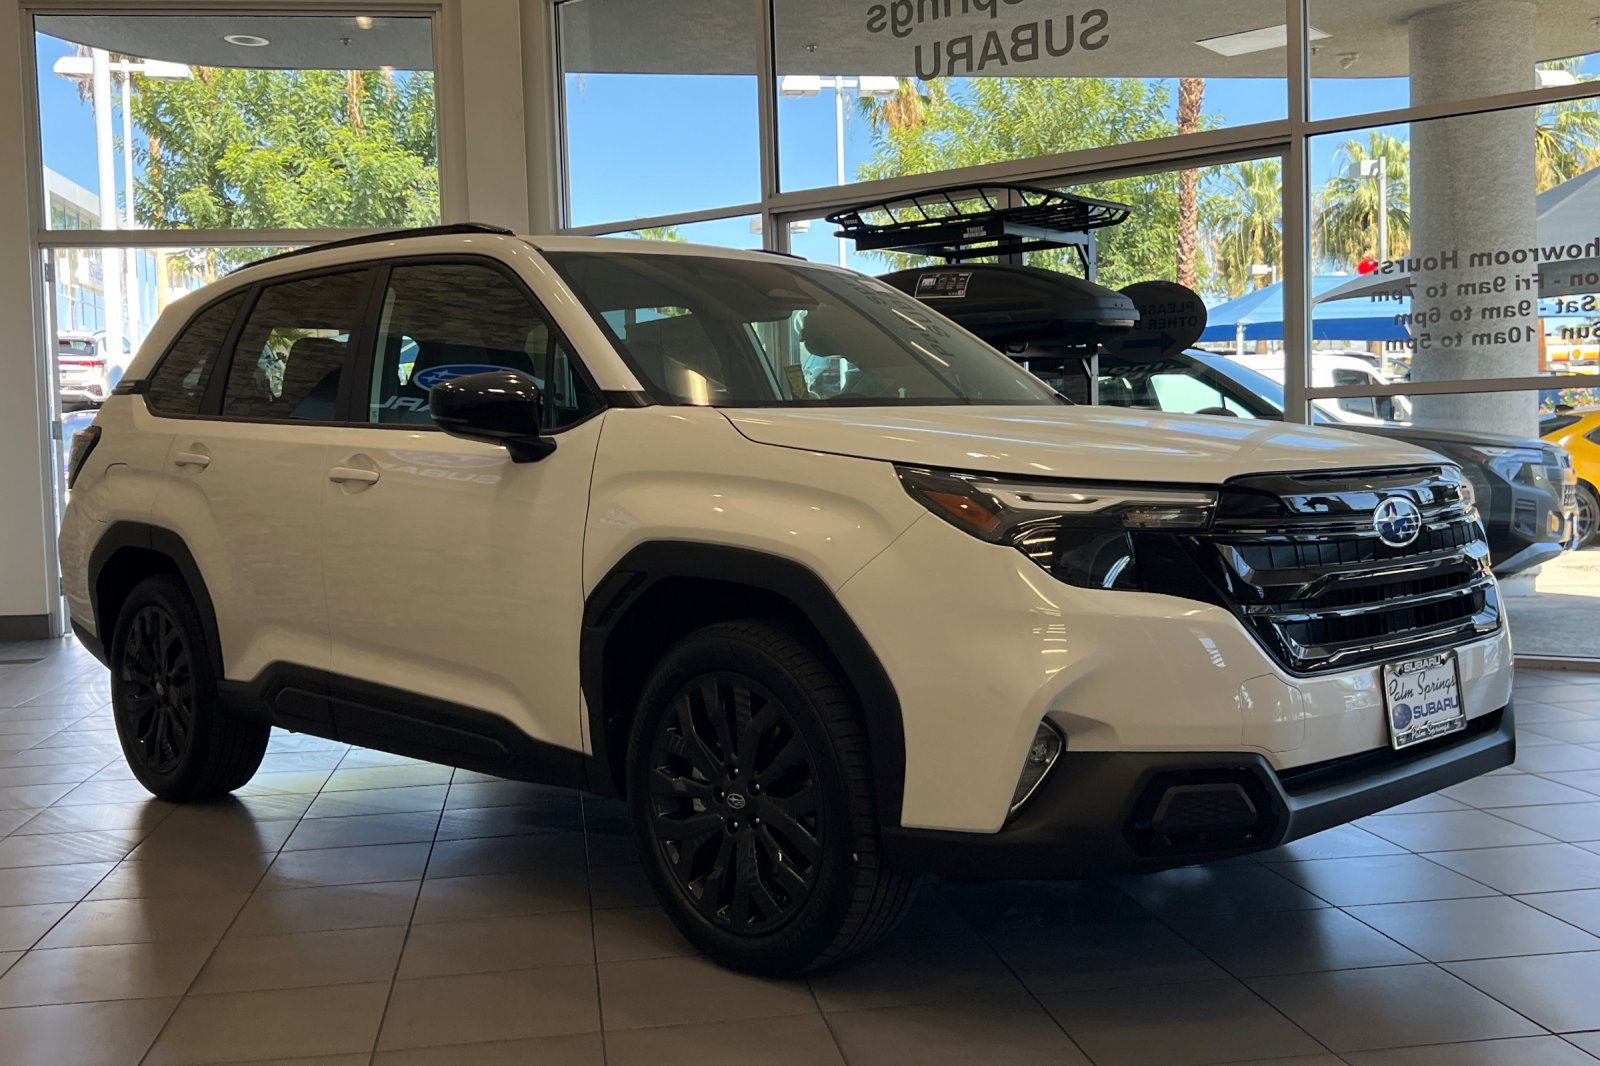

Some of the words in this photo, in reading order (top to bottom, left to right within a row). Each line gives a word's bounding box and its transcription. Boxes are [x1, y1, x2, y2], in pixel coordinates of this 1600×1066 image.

[1403, 655, 1441, 672] SUBARU
[1389, 679, 1414, 701] Palm
[1418, 671, 1456, 700] Springs
[1413, 695, 1458, 719] SUBARU
